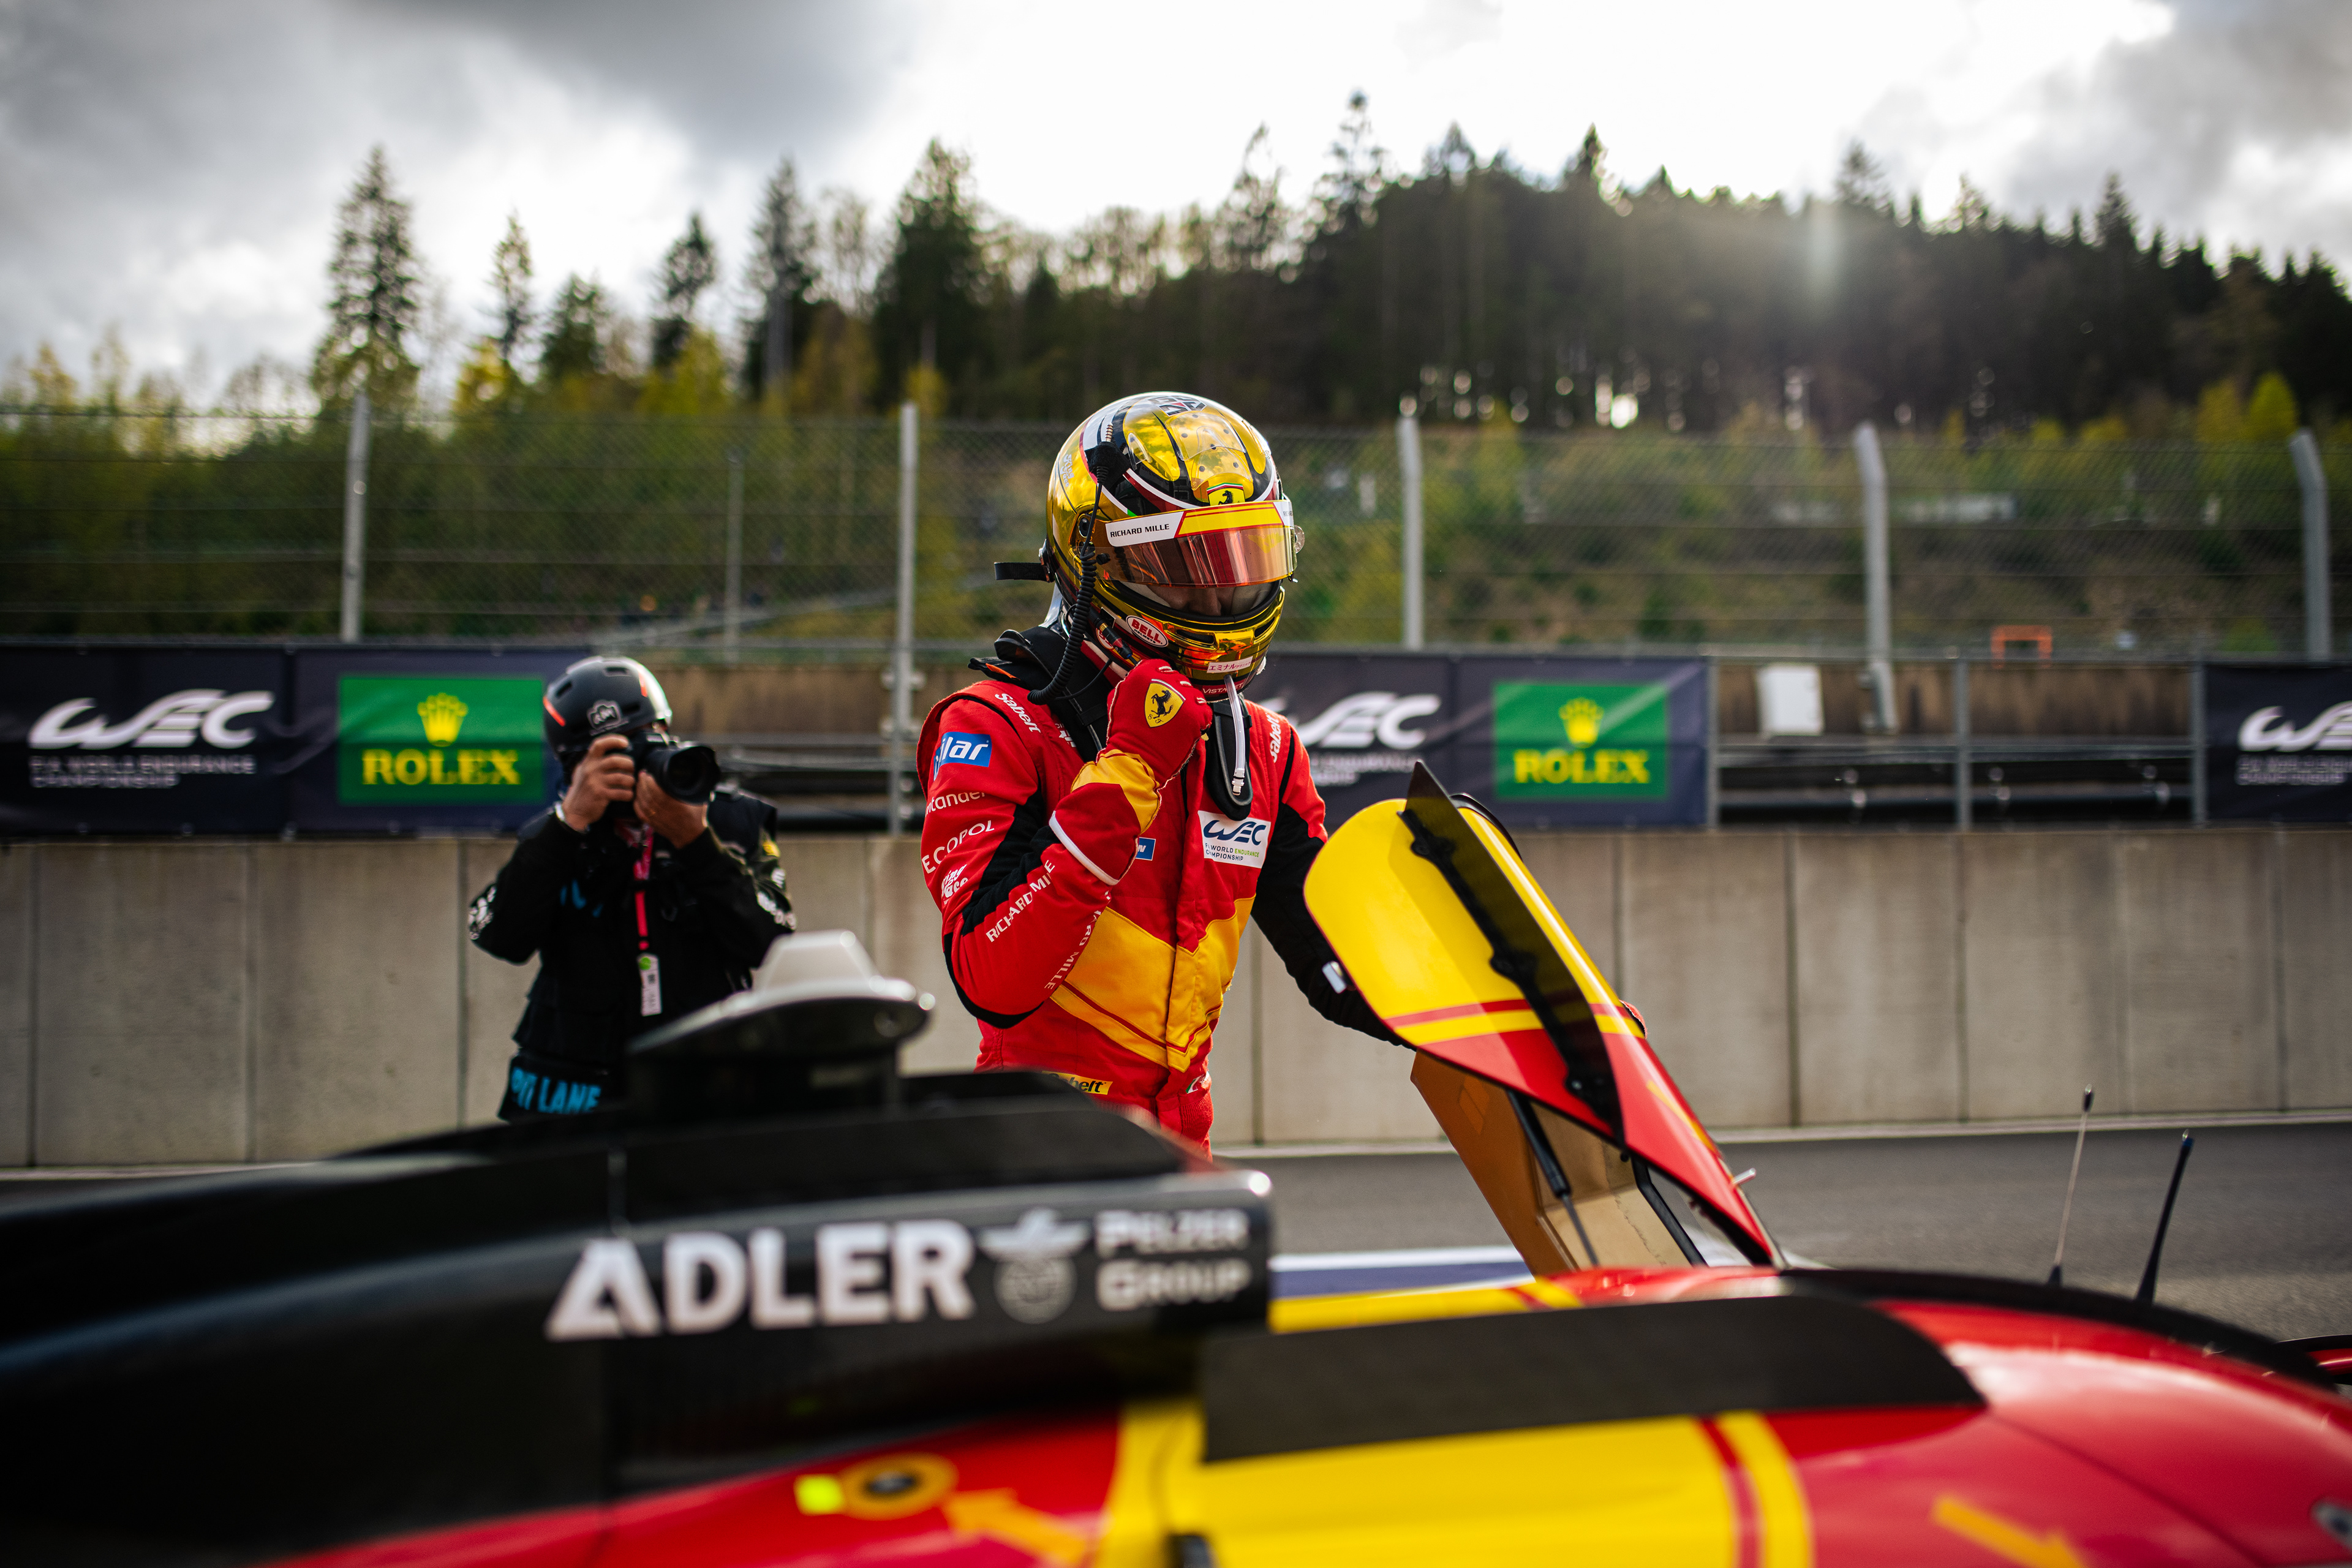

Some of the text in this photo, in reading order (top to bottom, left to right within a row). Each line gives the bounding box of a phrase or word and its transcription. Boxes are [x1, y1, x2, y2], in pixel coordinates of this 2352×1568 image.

[1063, 454, 1074, 480] King
[1110, 524, 1170, 538] RICHARD MILLE
[1131, 619, 1161, 644] BELL
[1134, 628, 1156, 644] HELMETS
[1202, 682, 1244, 694] VISTAET
[28, 687, 275, 751] WEC
[995, 693, 1041, 733] Sabelt
[1262, 692, 1442, 749] EC
[1265, 712, 1281, 763] Sabelt
[362, 749, 521, 786] ROLEX
[1513, 749, 1650, 784] ROLEX
[922, 820, 995, 874] ECOPOL
[1203, 820, 1267, 846] WEC
[1205, 850, 1244, 861] CMPIONSHIP
[1210, 845, 1234, 853] WORLD
[1234, 848, 1260, 858] ENDURANCE
[986, 859, 1055, 943] RICHARD MIE
[1044, 951, 1080, 990] MILLE
[1048, 1073, 1103, 1093] belt
[545, 1219, 976, 1340] ADLER
[1096, 1259, 1253, 1312] GROUP
